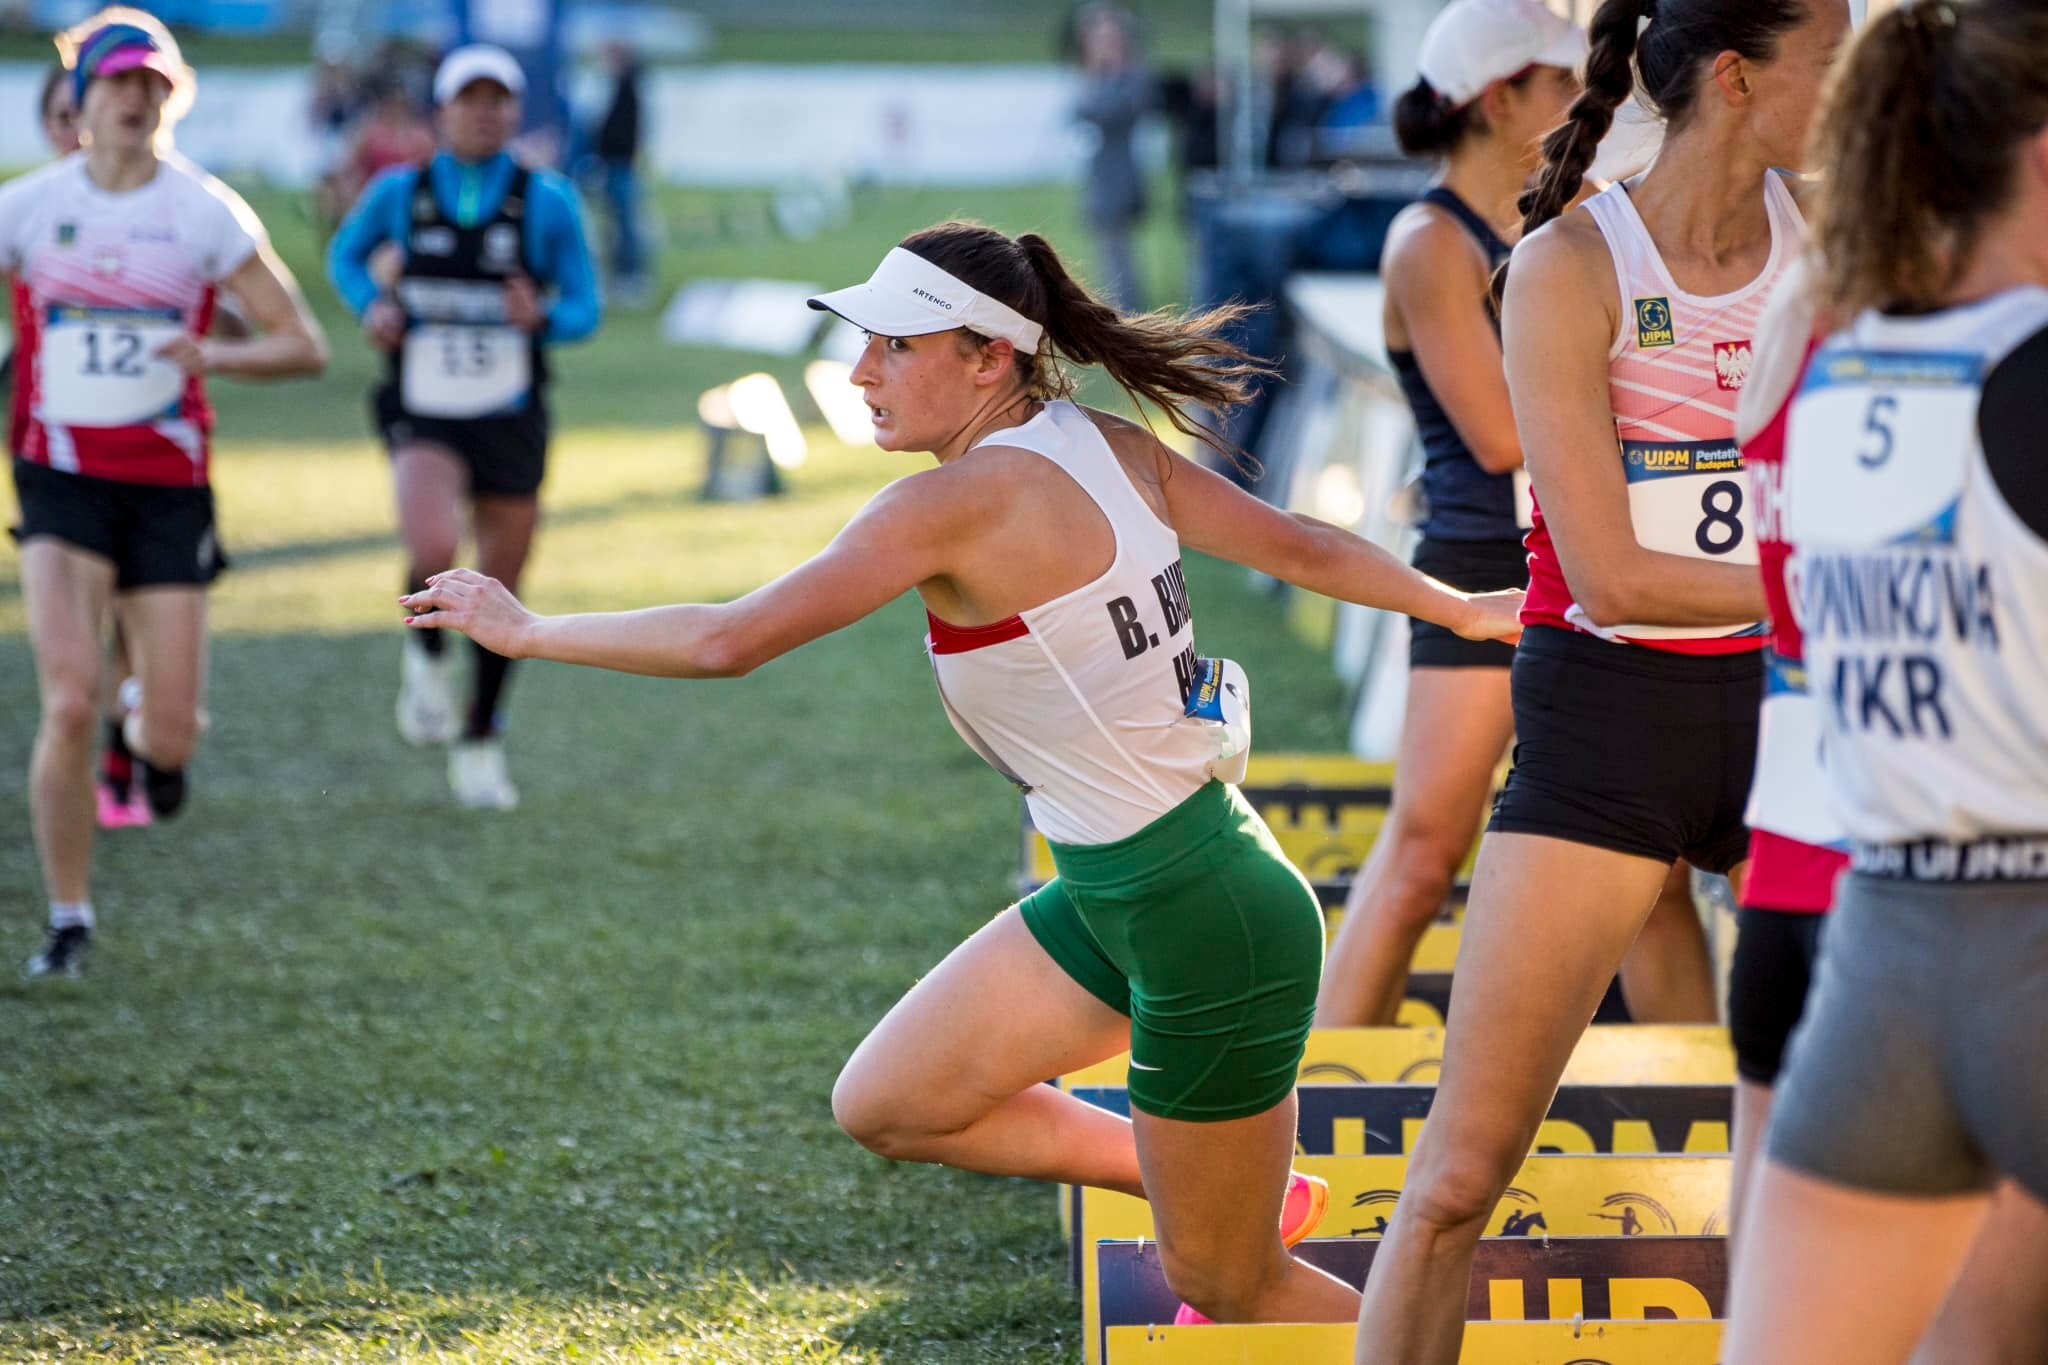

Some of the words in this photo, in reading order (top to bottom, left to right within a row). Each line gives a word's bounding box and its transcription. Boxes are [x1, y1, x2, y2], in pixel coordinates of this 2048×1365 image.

[912, 287, 952, 310] ARTENGO
[80, 330, 145, 377] 12
[1641, 330, 1671, 343] UIPM
[1857, 395, 1899, 470] 5
[1644, 448, 1690, 466] UIPM
[1695, 480, 1744, 554] 8
[1105, 595, 1161, 660] B.
[1150, 559, 1192, 637] BAU
